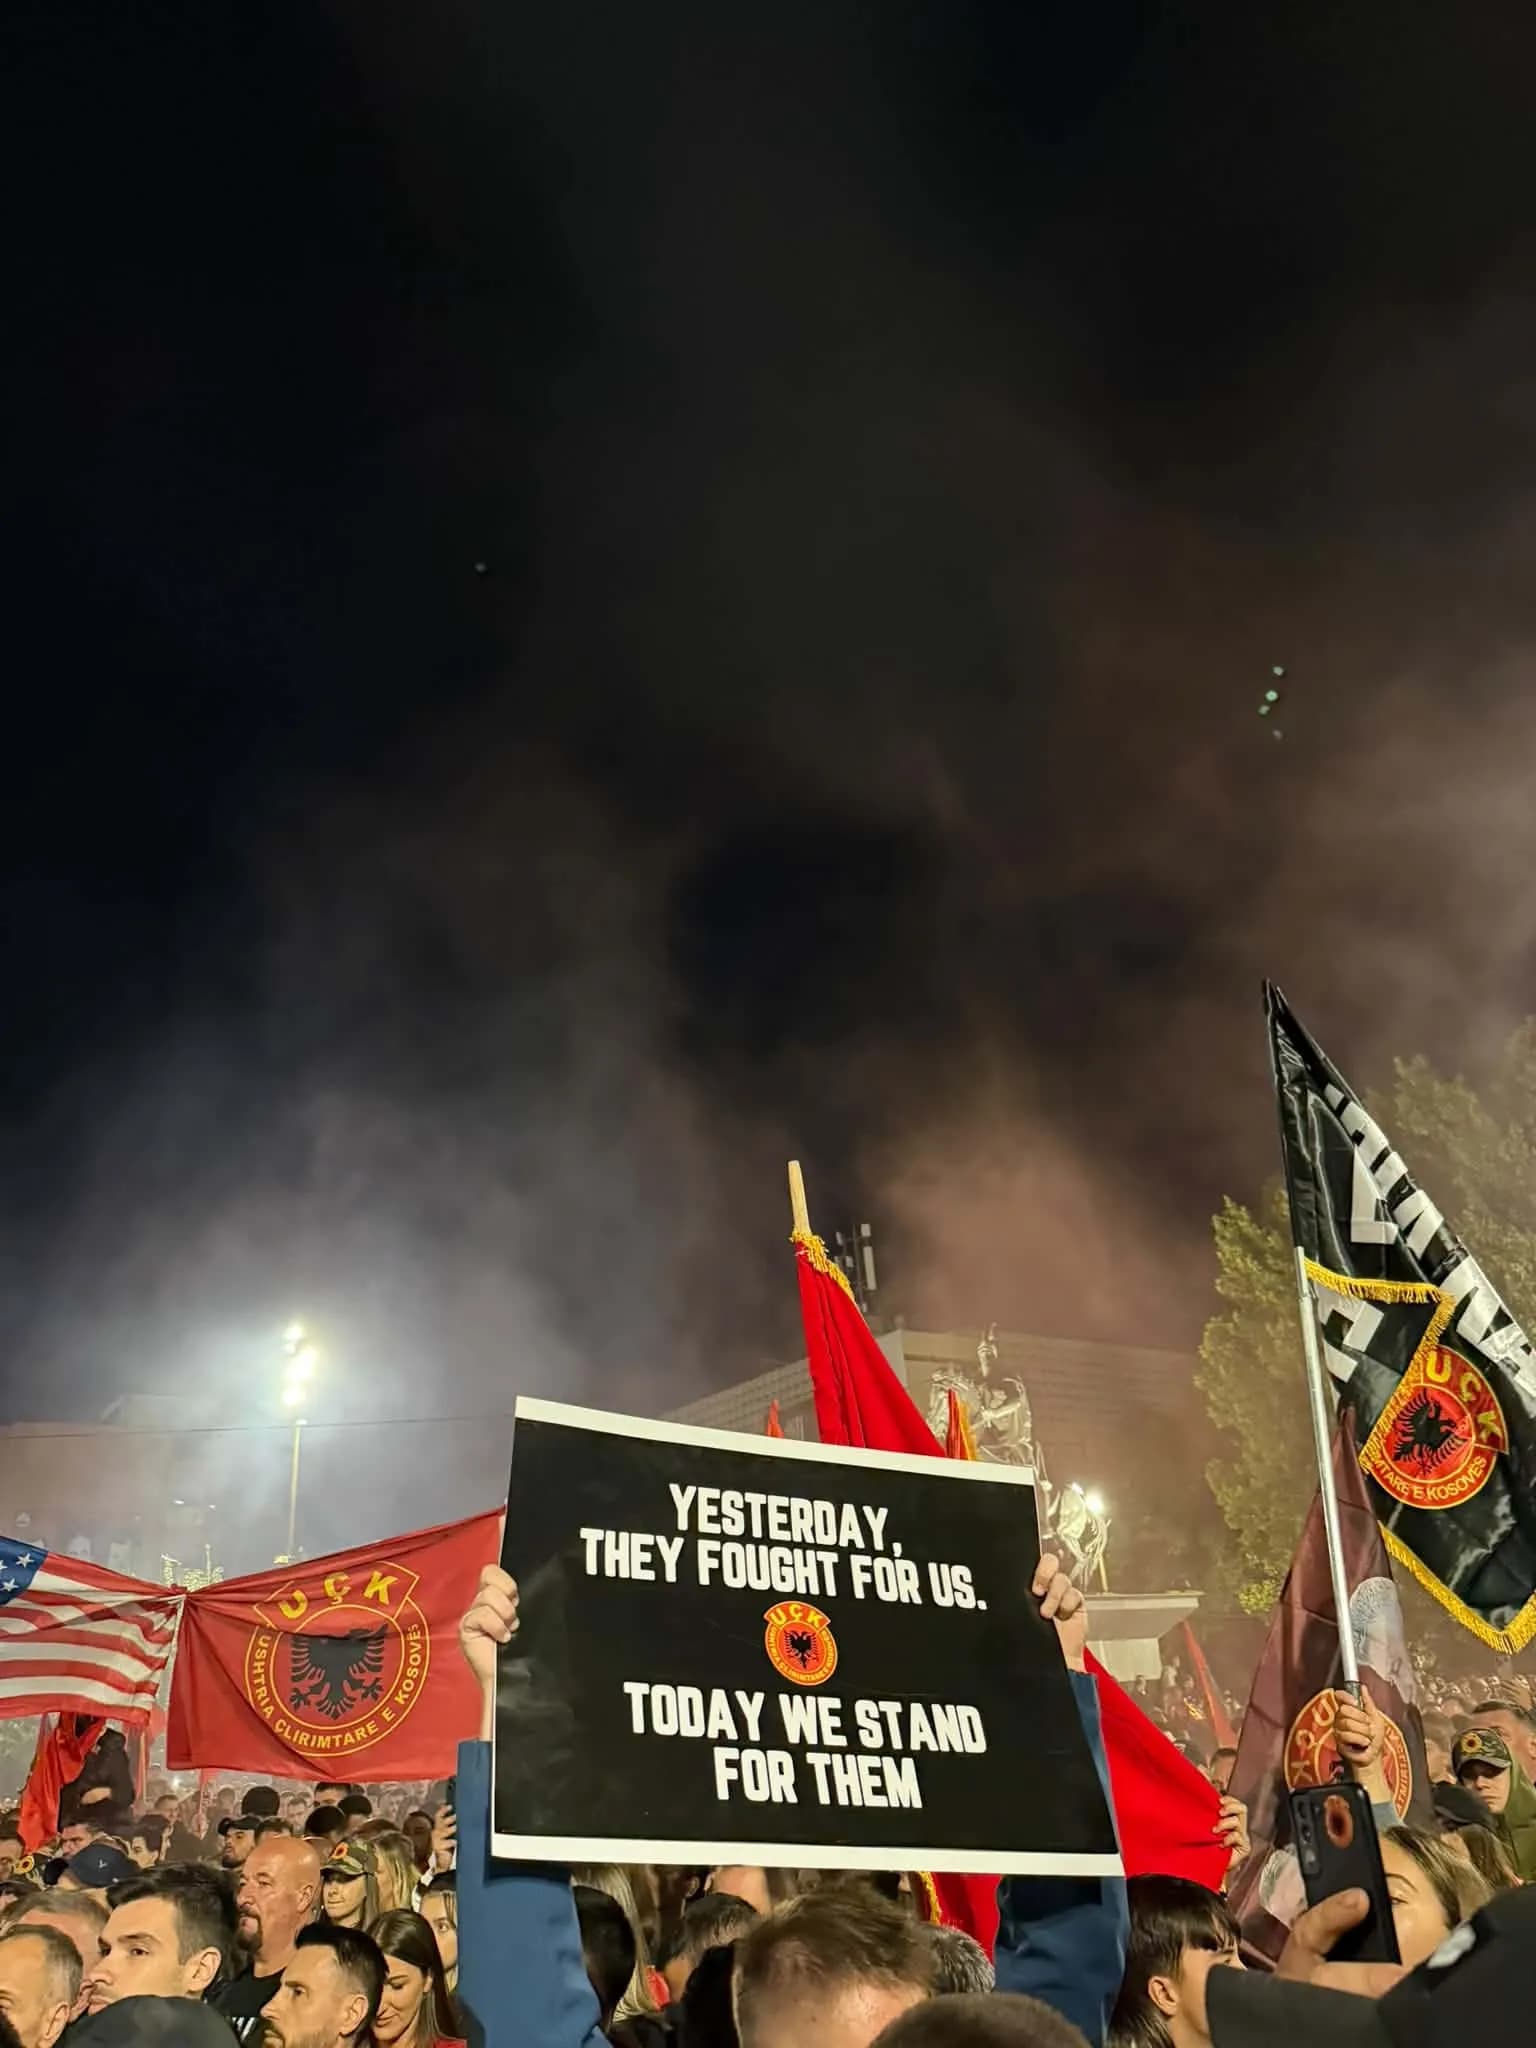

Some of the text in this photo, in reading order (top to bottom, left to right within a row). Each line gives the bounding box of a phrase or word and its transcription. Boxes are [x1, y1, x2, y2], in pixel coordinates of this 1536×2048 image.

[669, 1484, 902, 1557] YESTERDAY,
[278, 1571, 399, 1619] UÇK
[580, 1528, 987, 1610] THEY FOUGHT FOR US.
[769, 1603, 824, 1629] UÇK
[252, 1634, 276, 1720] USHTRIA
[381, 1706, 396, 1722] E
[624, 1682, 986, 1753] TODAY WE STAND
[714, 1747, 922, 1808] FOR THEM
